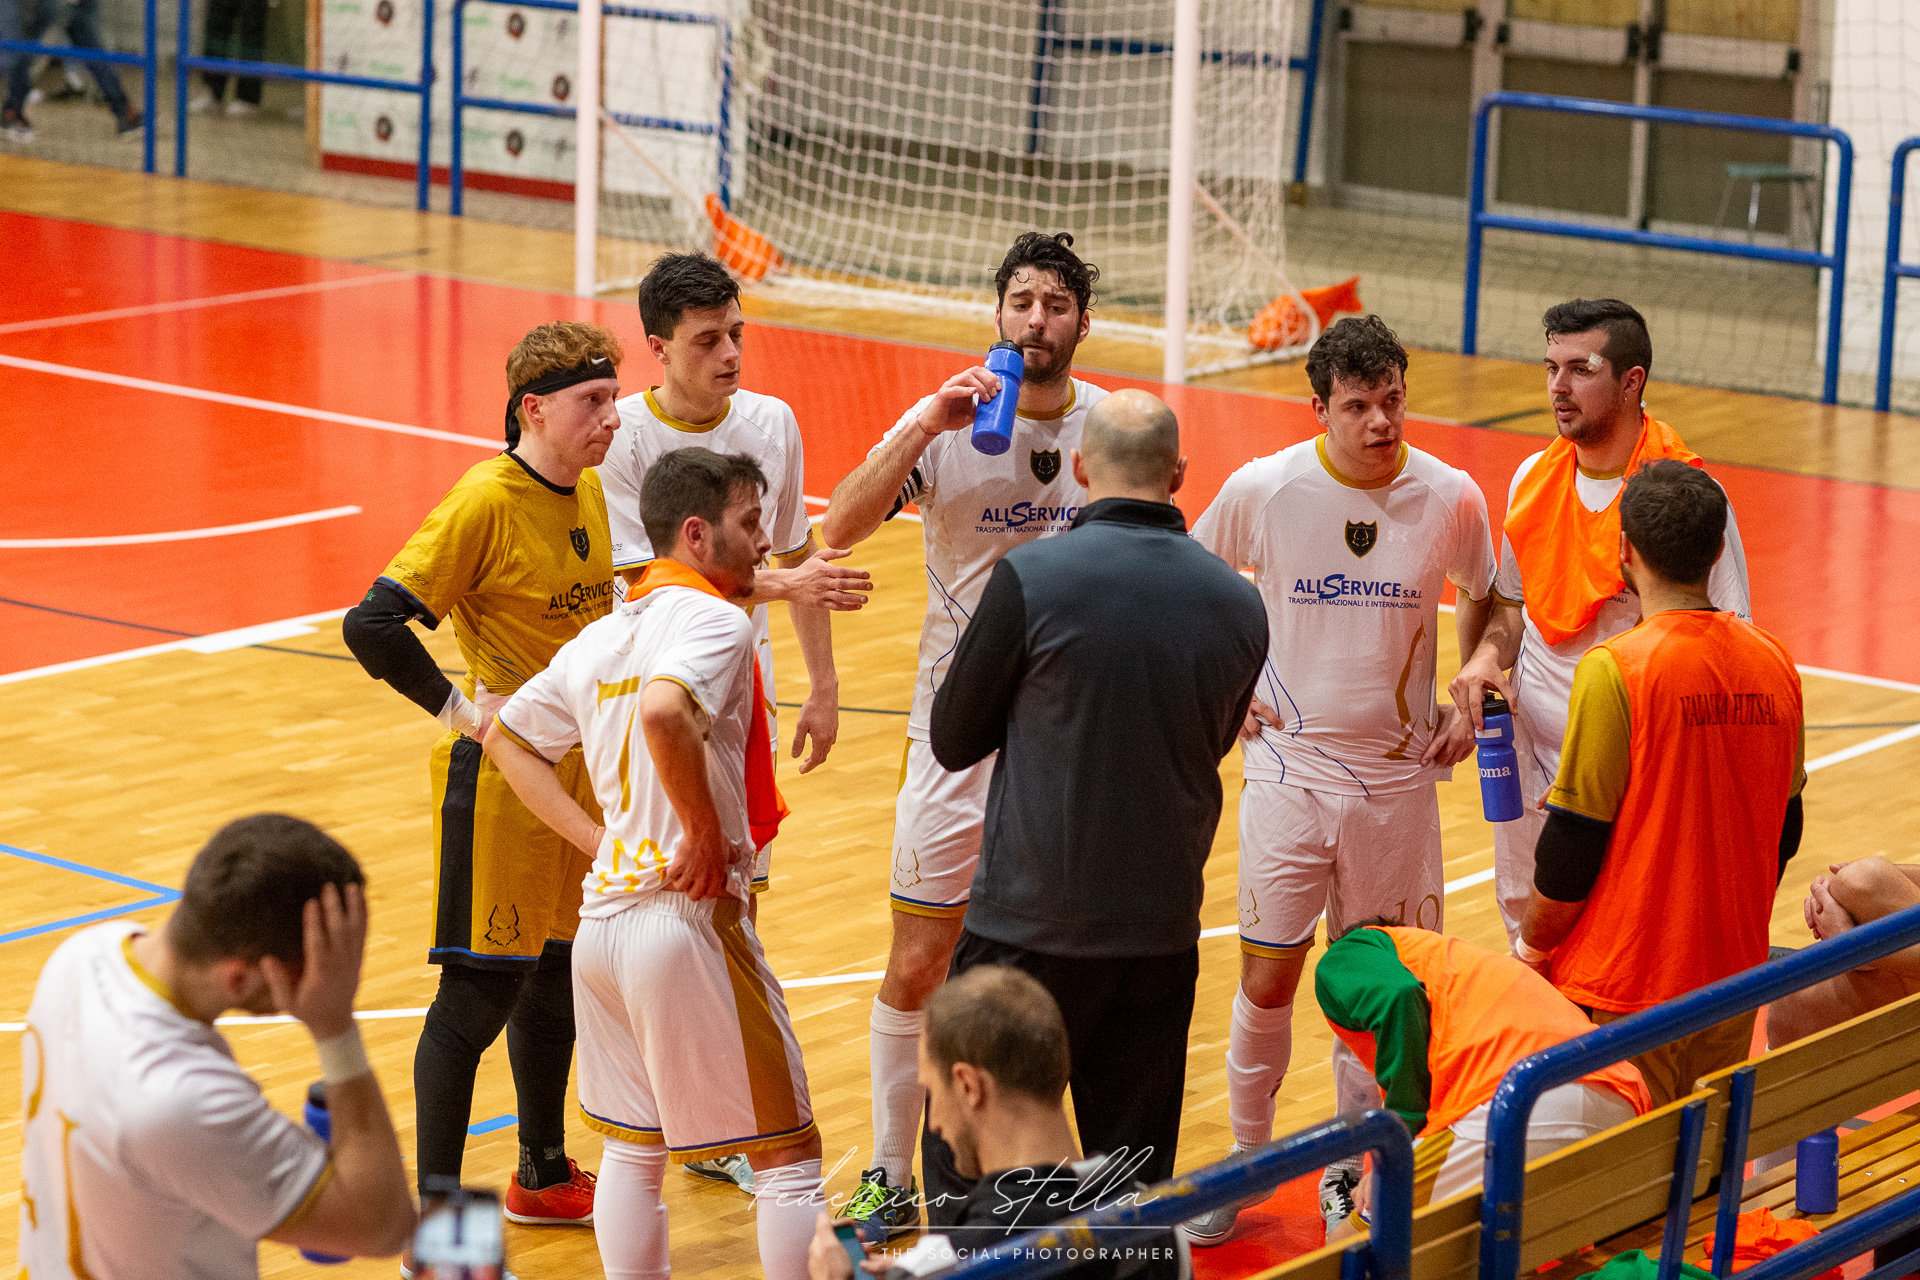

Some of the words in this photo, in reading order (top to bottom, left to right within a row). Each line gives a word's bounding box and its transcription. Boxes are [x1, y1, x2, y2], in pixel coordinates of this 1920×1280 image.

[548, 580, 611, 611] ALLSERVICE
[1294, 573, 1402, 600] ALLSERVICE
[1288, 597, 1325, 606] TRASPORTI
[1326, 598, 1363, 607] NAZIONALI
[1371, 601, 1421, 610] INTERNAZIONAL
[1732, 693, 1778, 726] FUTSAL
[1395, 894, 1440, 931] 10
